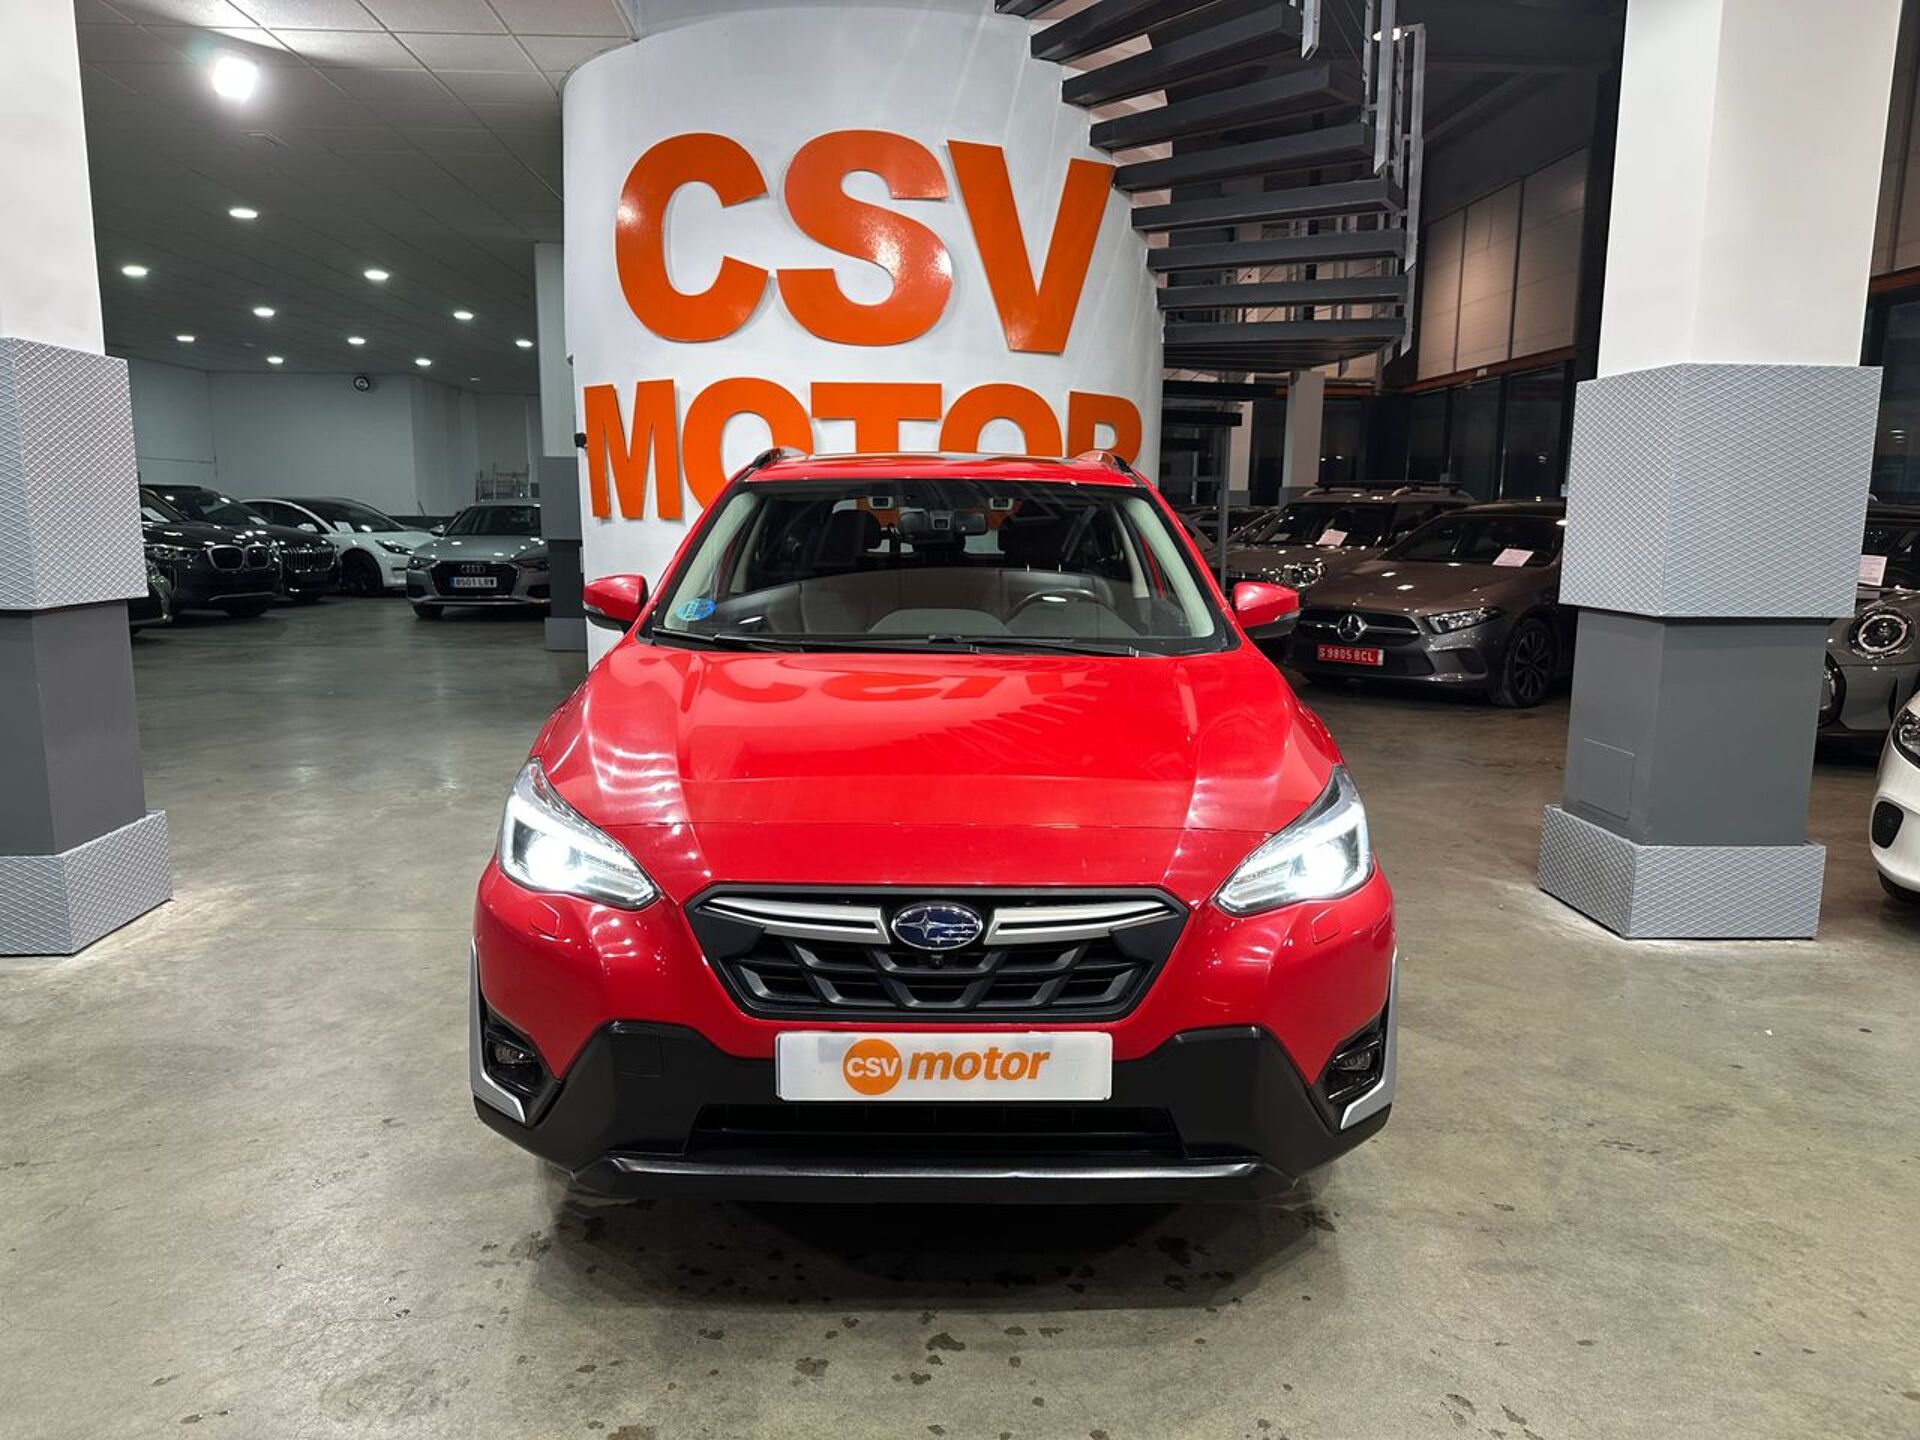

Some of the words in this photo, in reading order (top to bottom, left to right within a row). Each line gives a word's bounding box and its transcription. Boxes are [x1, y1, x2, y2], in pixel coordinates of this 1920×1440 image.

[615, 129, 1116, 354] CSV
[848, 1056, 899, 1078] CSV
[907, 1047, 1051, 1081] motor
